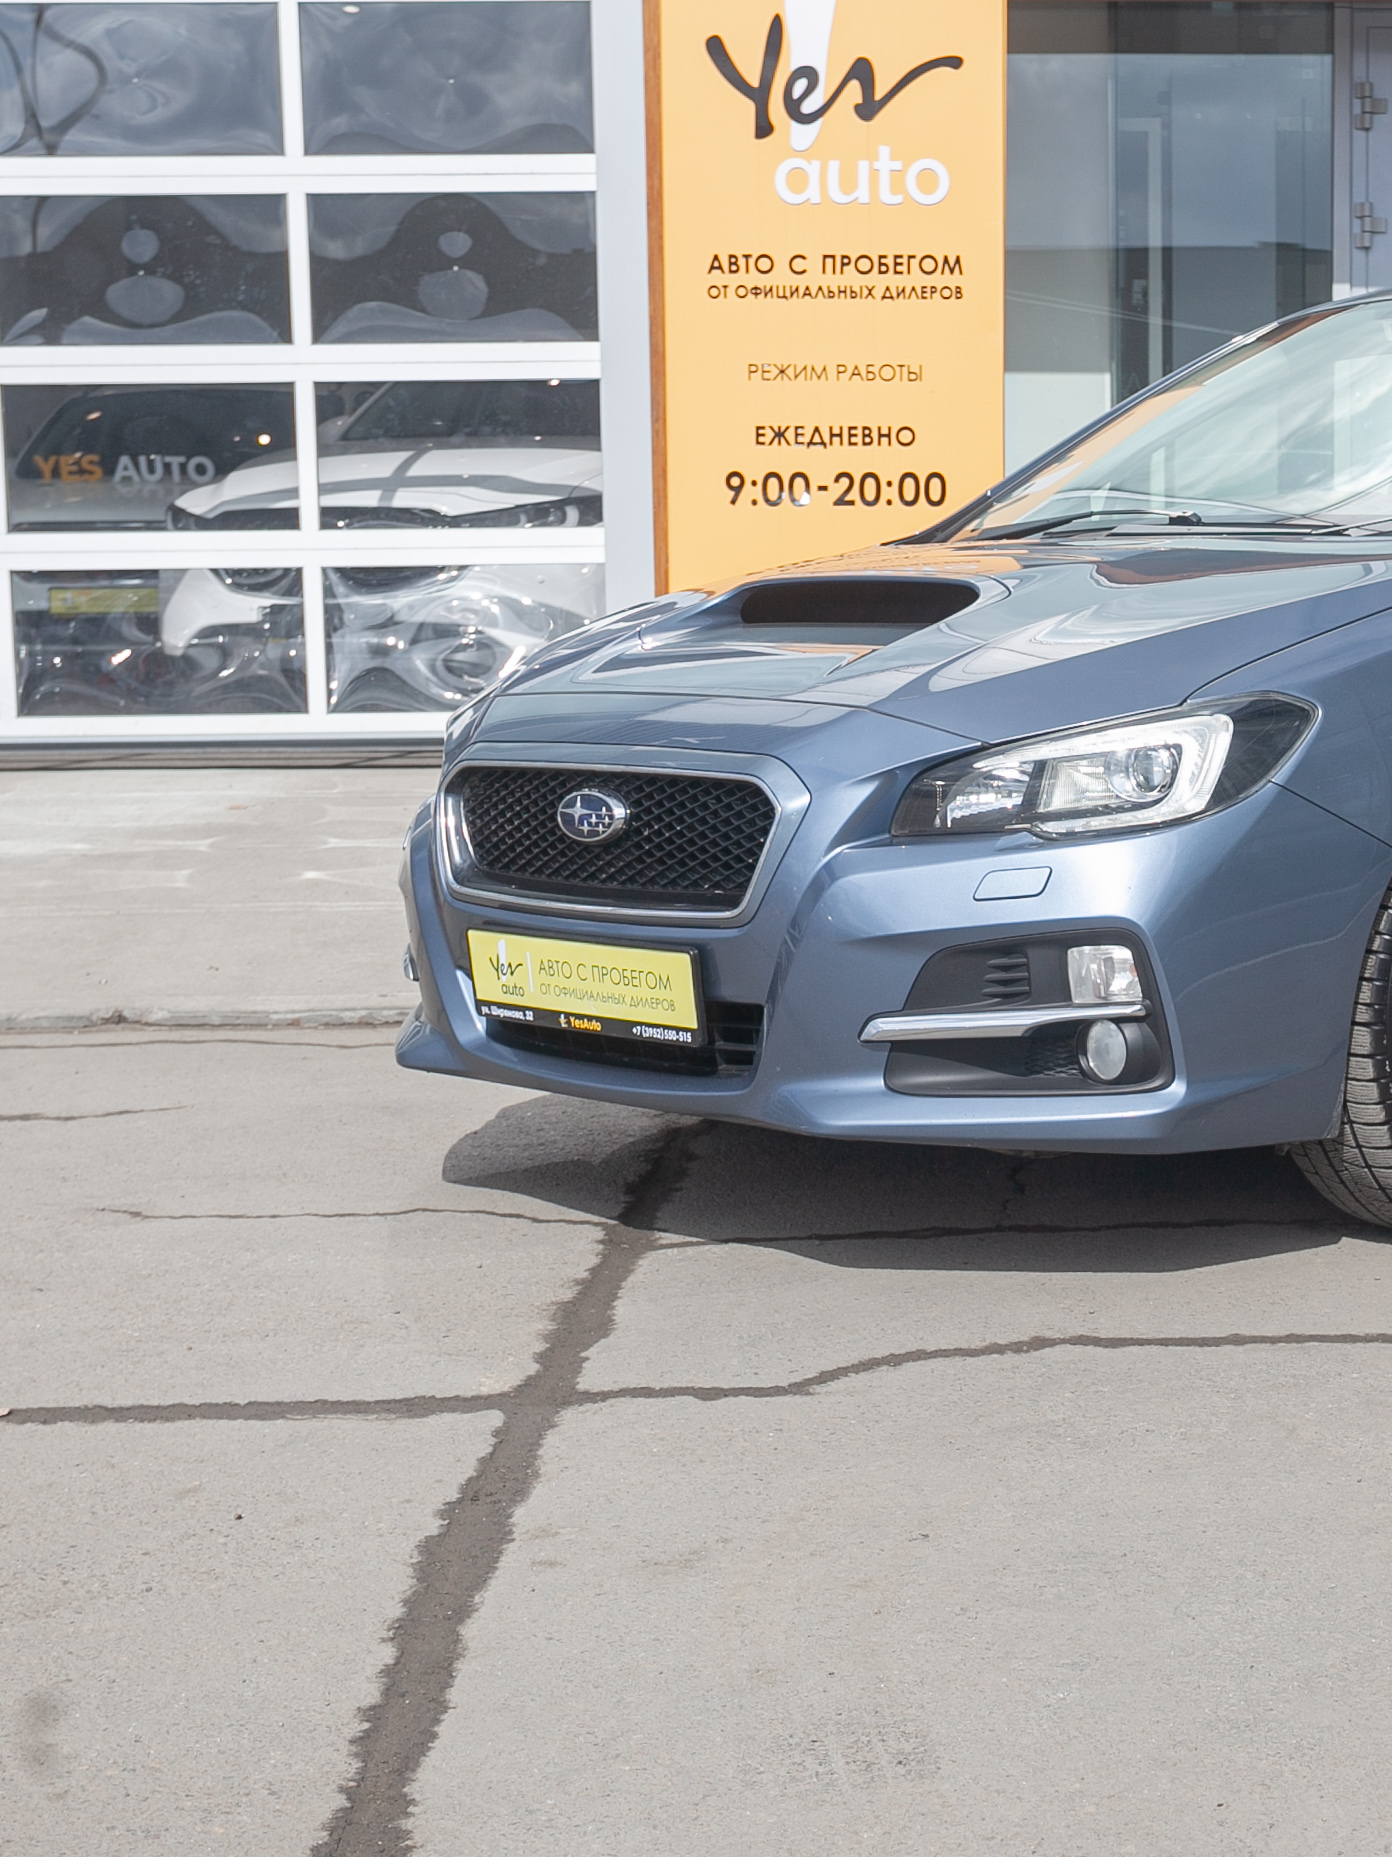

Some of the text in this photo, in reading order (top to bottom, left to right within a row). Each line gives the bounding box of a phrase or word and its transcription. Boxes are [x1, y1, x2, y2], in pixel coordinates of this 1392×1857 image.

[705, 13, 964, 140] Yes
[774, 145, 950, 206] auto
[708, 254, 963, 275] АВТО С ПРОБЕГОМ
[707, 284, 963, 301] ОТ ОФИЦИАЛЬНЫХ ДИЛЕРОВ
[748, 364, 923, 382] РЕЖИМ РАБОТЫ
[755, 426, 916, 448] ЕЖЕДНЕВНО
[33, 454, 216, 484] YES AUTO
[725, 471, 947, 507] 9:00-20:00
[538, 959, 673, 992] АВТО С ПРОБЕГОМ
[501, 983, 525, 998] auto
[539, 982, 676, 1013] ОТ ОФИЦИАЛЬНЫХ ДИЛЕРОВ
[569, 1016, 602, 1031] YesAuto
